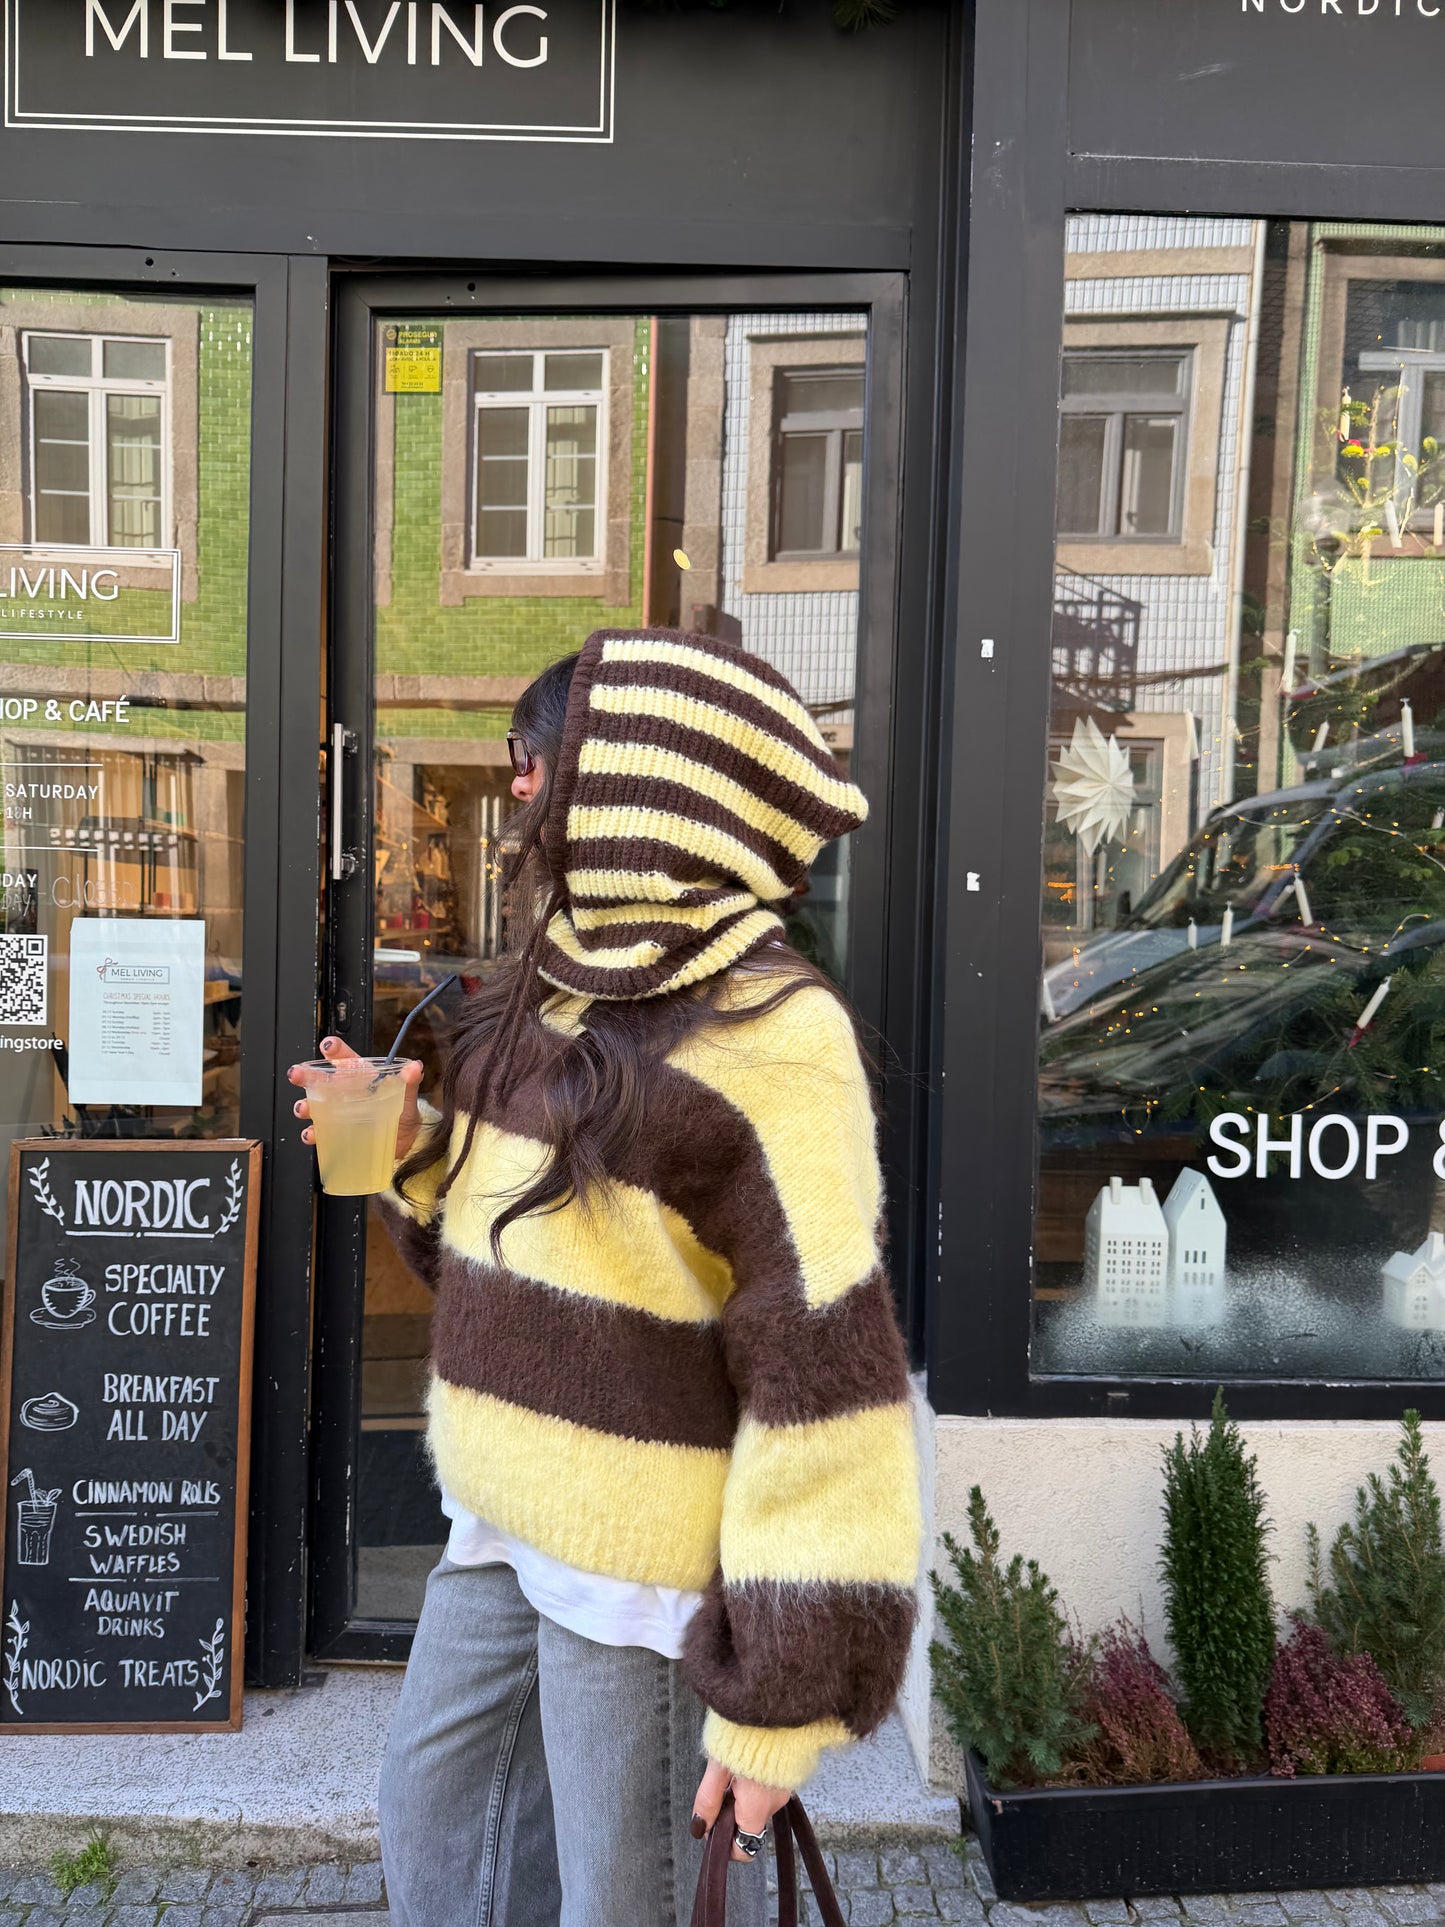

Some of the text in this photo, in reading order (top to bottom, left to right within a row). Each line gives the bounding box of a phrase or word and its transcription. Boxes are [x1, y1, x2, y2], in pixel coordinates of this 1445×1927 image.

[85, 0, 549, 69] MEL LIVING
[0, 567, 119, 601] IVING
[1, 608, 84, 620] LIFESTYLE
[45, 700, 63, 722] &
[69, 695, 131, 723] CAFÉ
[5, 783, 99, 800] SATURDAY
[111, 968, 163, 978] MEL LIVING
[1206, 1112, 1410, 1181] SHOP
[74, 1178, 210, 1229] NORDIC
[104, 1264, 226, 1296] SPECIALTY
[108, 1302, 212, 1337] COFFEE
[102, 1373, 220, 1404] BREAKFAST
[106, 1409, 208, 1443] ALL DAY
[180, 1480, 221, 1505] ROLLS
[90, 1552, 180, 1575] WAFFLES
[118, 1658, 200, 1688] TREATS
